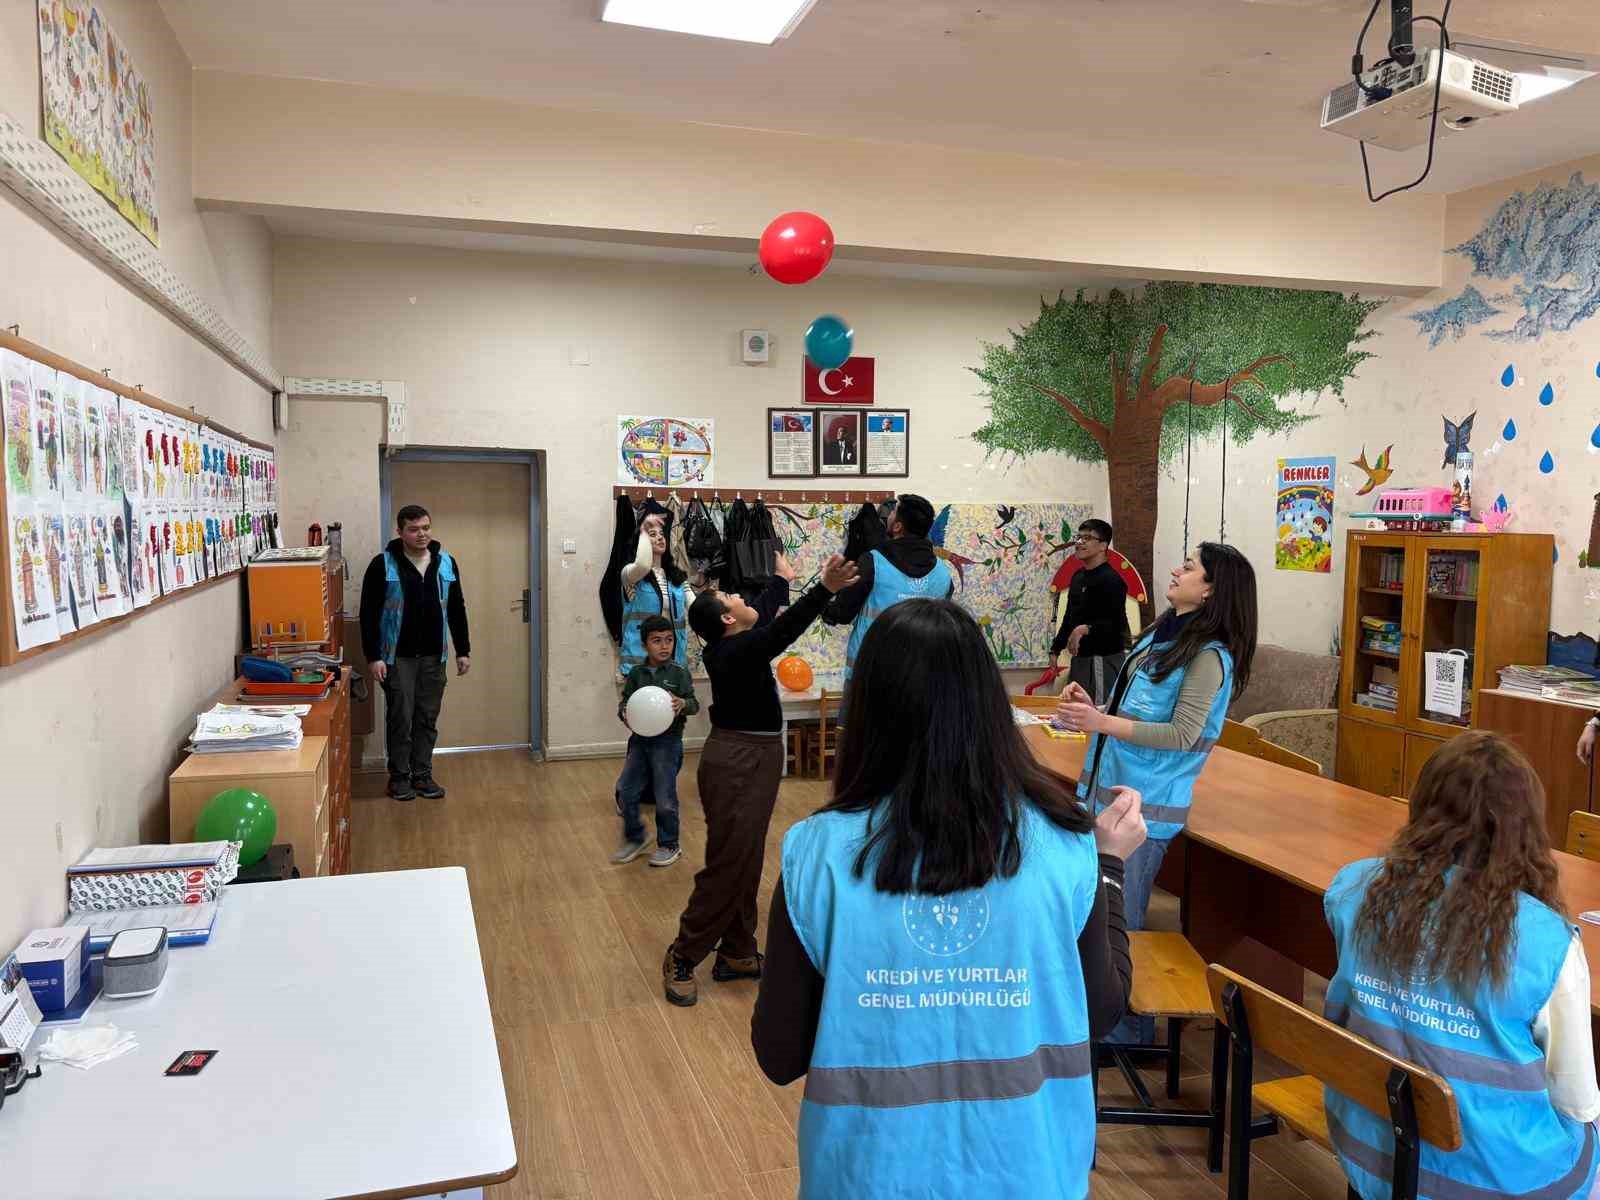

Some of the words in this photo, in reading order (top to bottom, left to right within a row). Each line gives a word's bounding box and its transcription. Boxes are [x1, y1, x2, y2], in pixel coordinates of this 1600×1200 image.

[1283, 465, 1330, 482] RENKLER
[866, 966, 918, 985] KREDİ
[921, 968, 944, 984] VE
[947, 967, 1028, 983] YURTLAR
[858, 992, 915, 1009] GENEL
[919, 987, 1031, 1009] MÜDÜRLÜĞÜ
[1410, 991, 1476, 1021] YURTLAR
[1391, 1001, 1481, 1040] MÜDÜRLÜĞÜ
